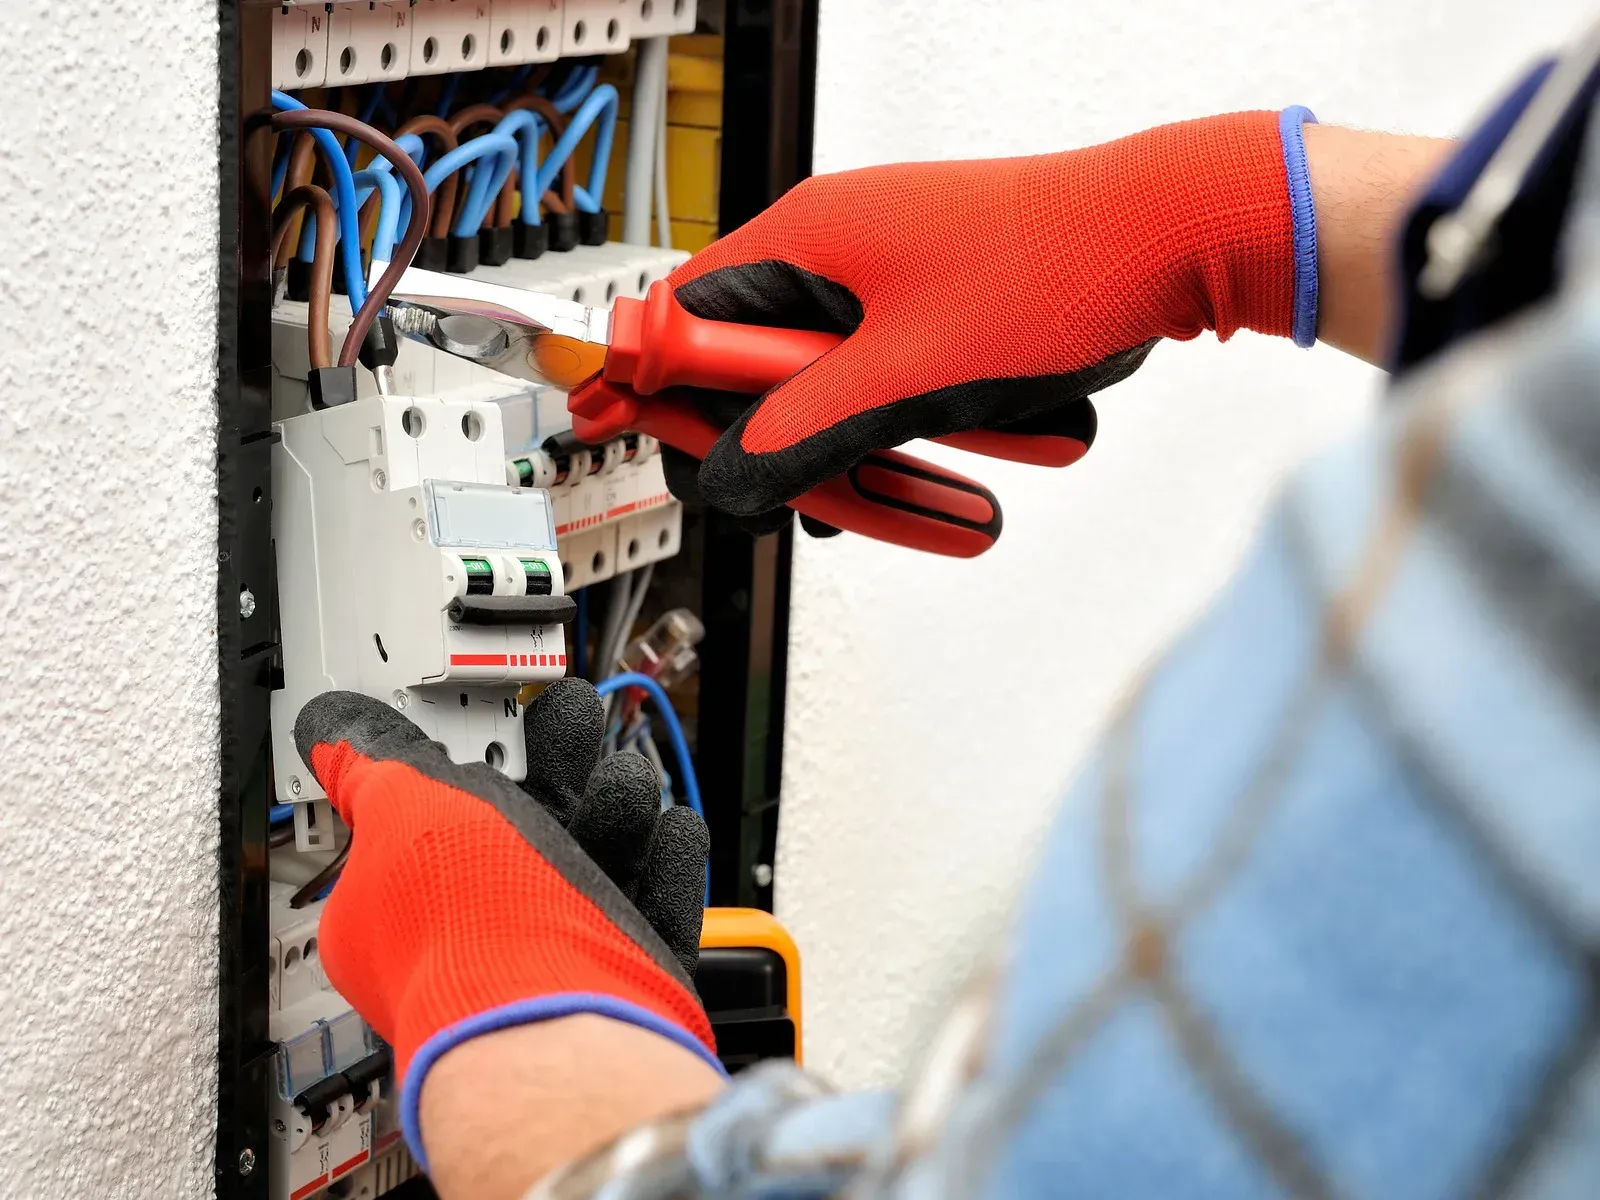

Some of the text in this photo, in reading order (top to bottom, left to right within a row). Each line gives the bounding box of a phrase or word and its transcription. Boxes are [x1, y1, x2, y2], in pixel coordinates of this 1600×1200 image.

[311, 16, 320, 33] N
[396, 11, 406, 28] N
[503, 697, 518, 718] N
